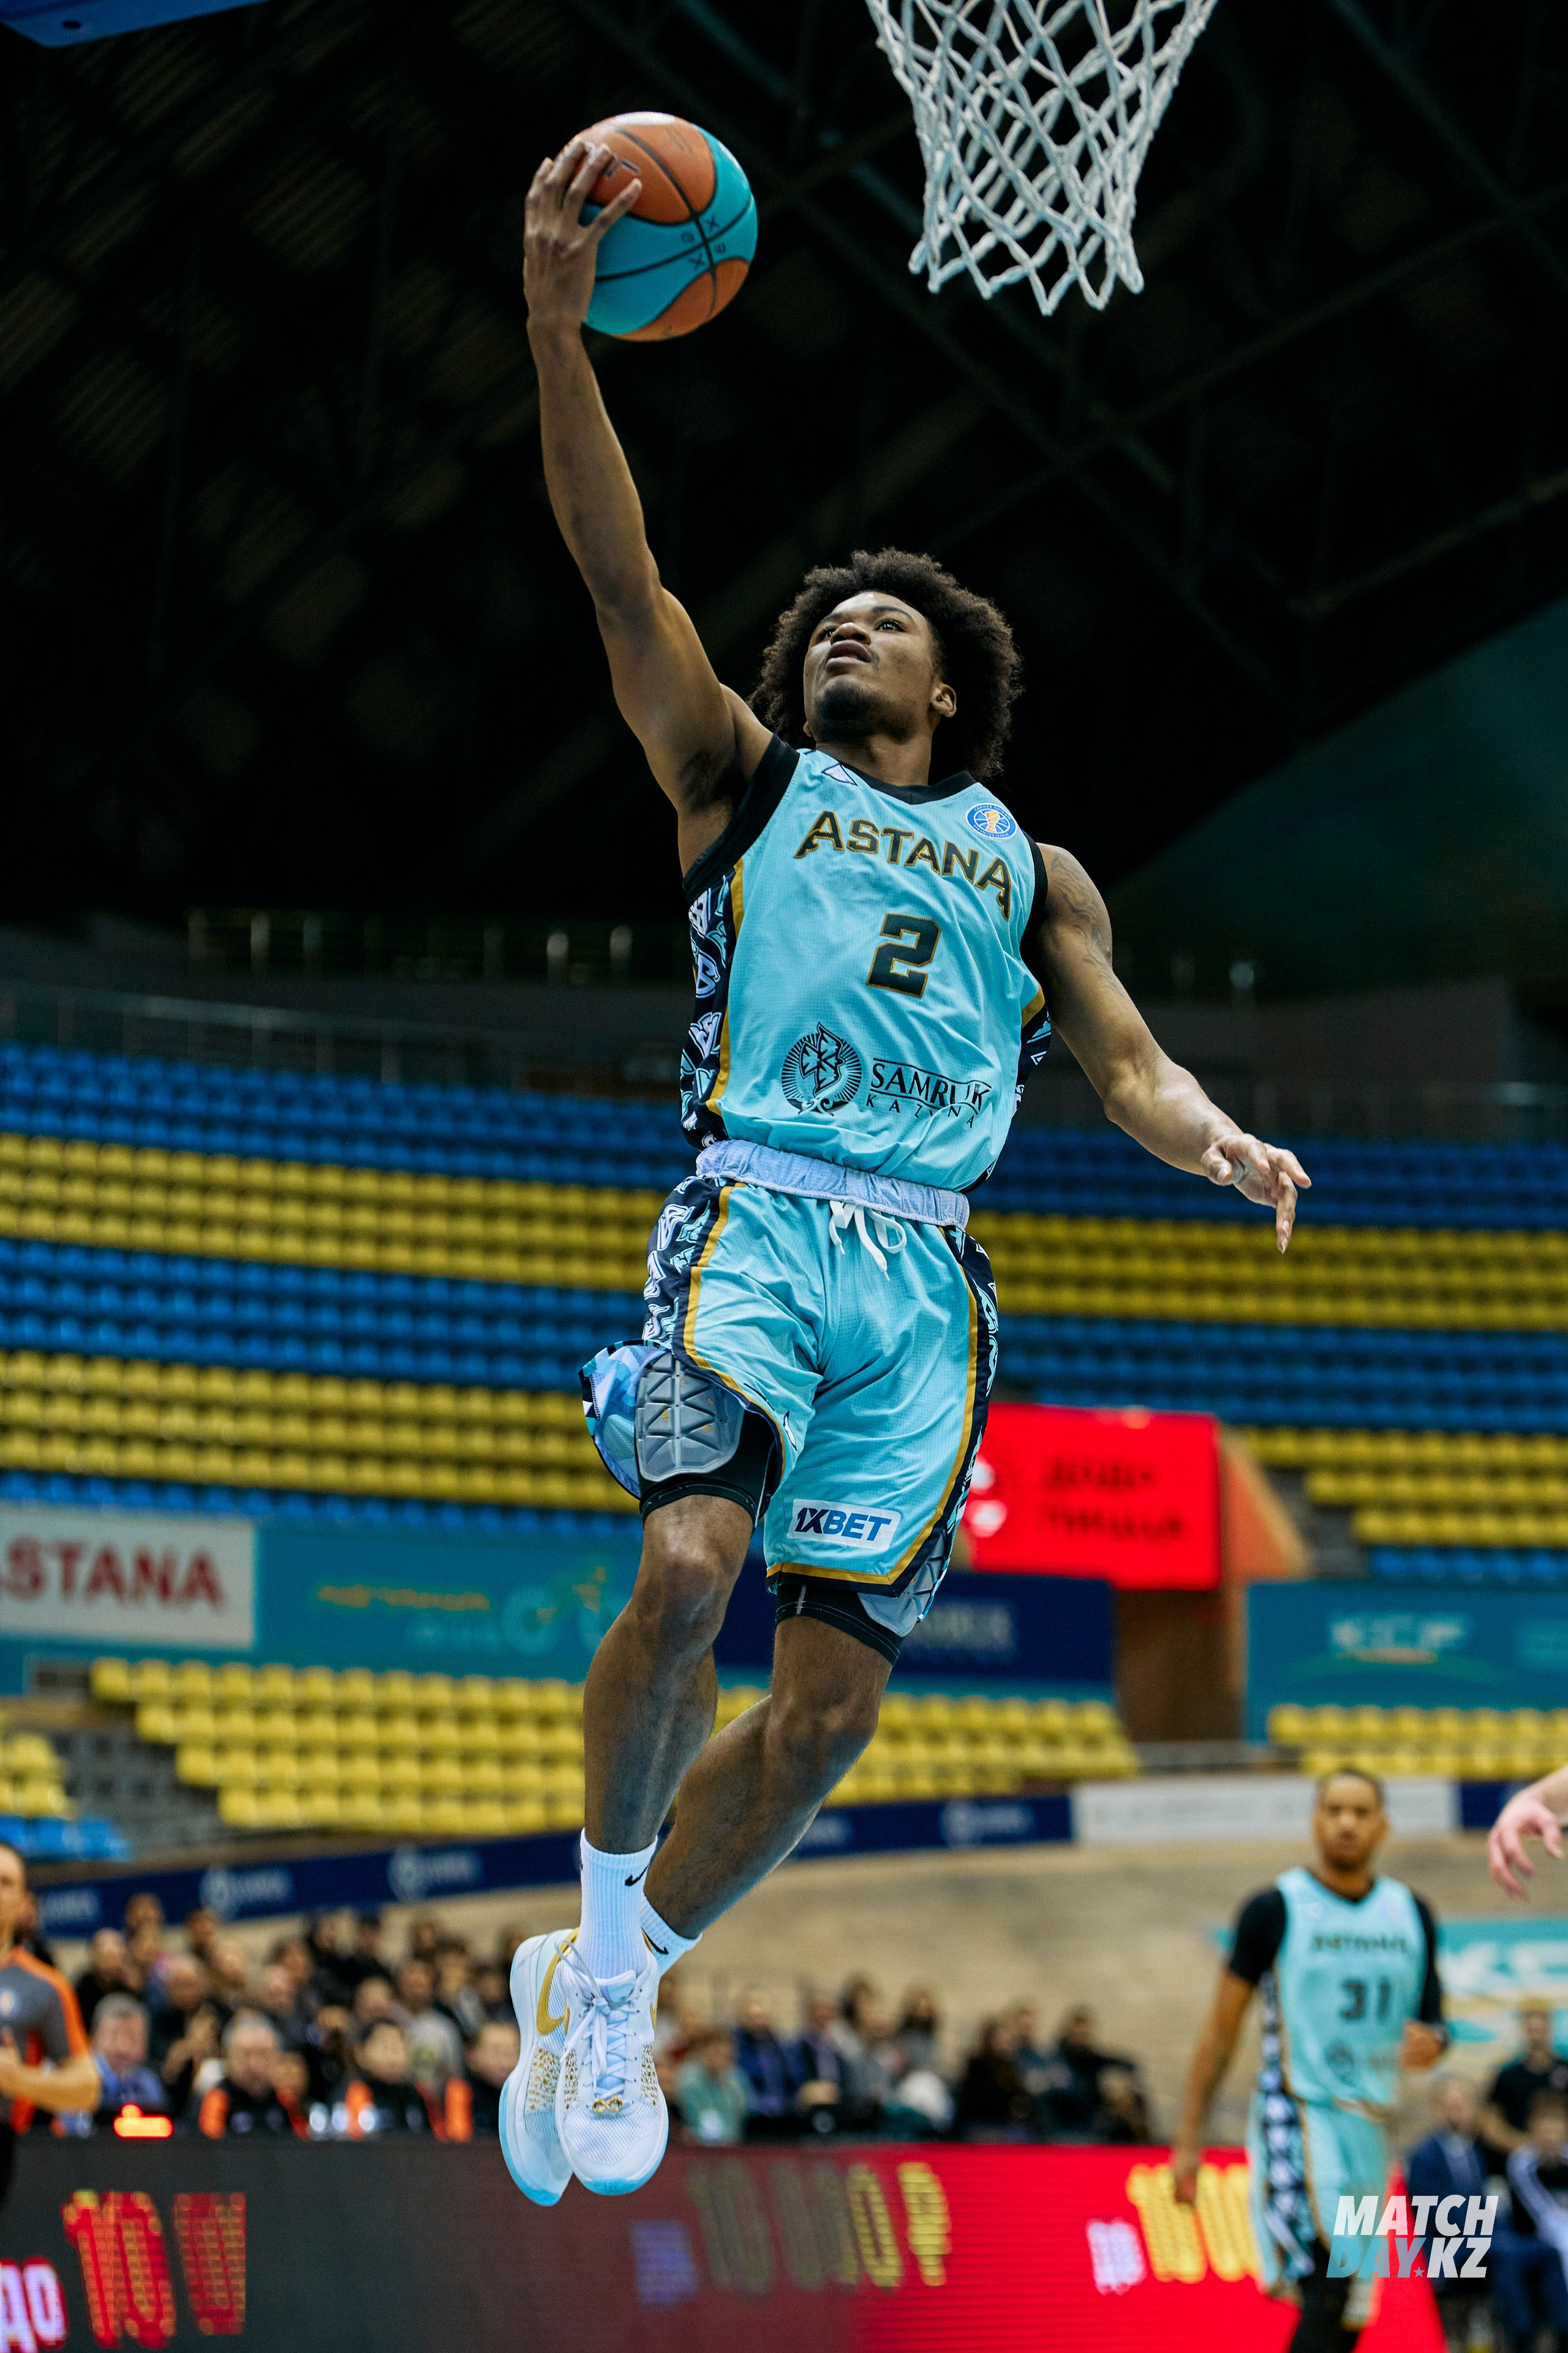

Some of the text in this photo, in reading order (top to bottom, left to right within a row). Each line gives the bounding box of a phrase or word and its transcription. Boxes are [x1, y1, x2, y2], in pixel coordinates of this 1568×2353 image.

[794, 810, 1011, 921] ASTANA
[865, 913, 941, 999] 2
[870, 1063, 990, 1111] SAMRUK
[794, 1508, 892, 1541] 1XBET
[0, 1536, 227, 1616] STANA
[1340, 1978, 1391, 2020] 31
